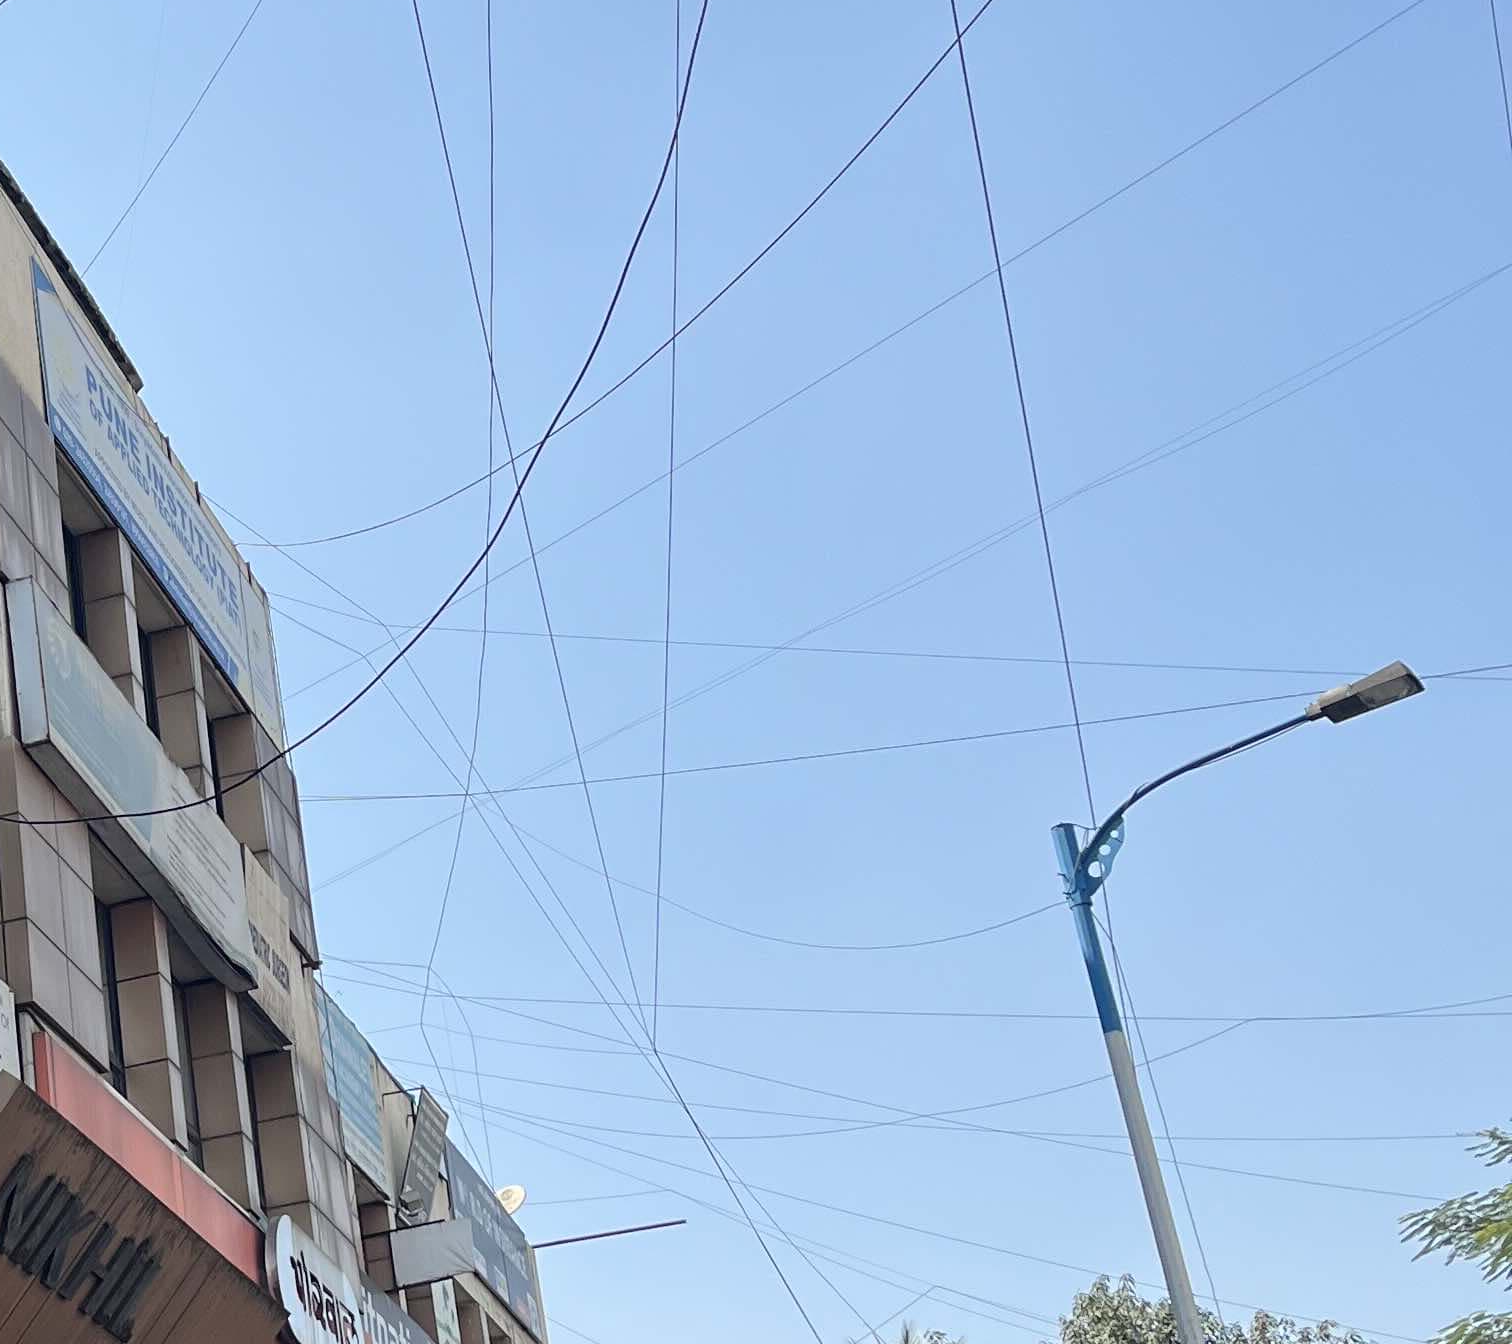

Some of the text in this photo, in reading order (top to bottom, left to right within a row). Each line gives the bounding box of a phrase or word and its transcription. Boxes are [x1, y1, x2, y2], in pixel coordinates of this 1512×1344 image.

[85, 363, 142, 458] PUNE
[145, 451, 239, 608] INSTITUTE
[106, 424, 150, 498] APPLIED
